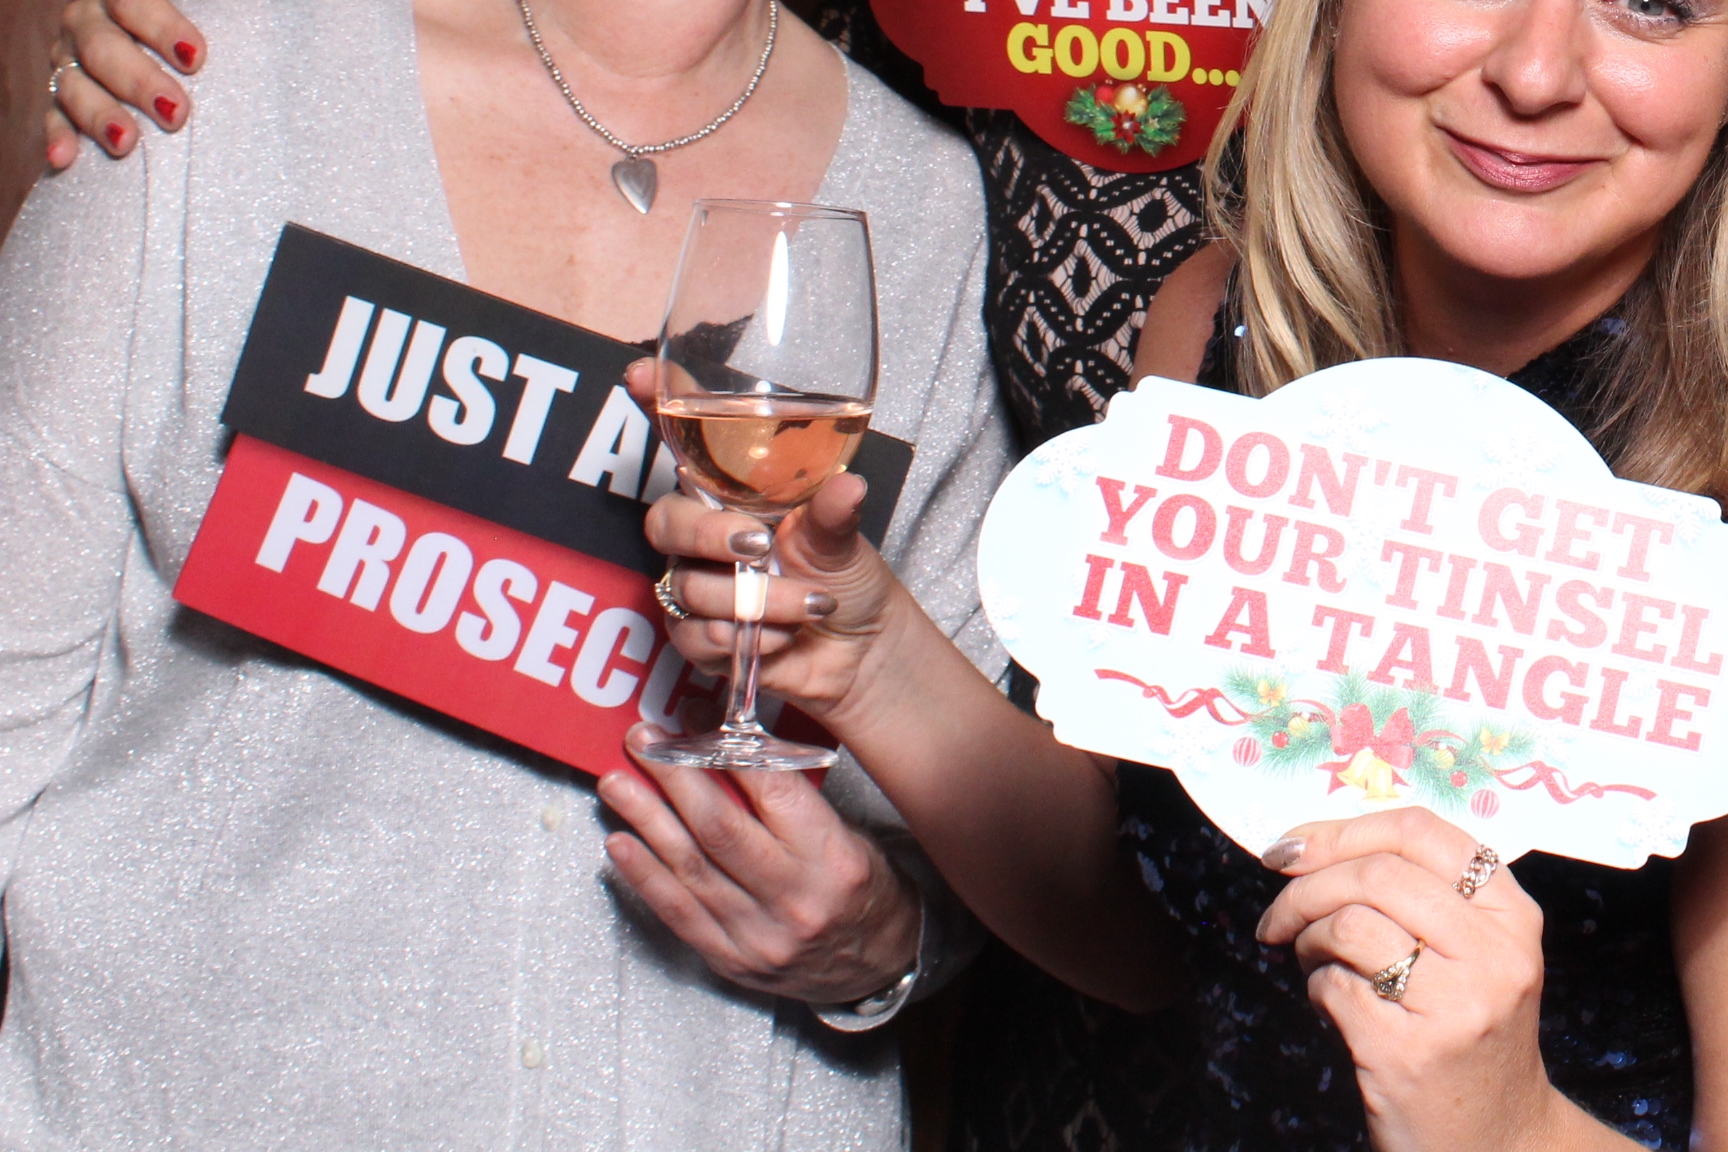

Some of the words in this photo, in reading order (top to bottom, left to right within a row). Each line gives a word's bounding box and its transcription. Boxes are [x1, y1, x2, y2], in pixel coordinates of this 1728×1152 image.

[1007, 22, 1241, 87] GOOD...
[304, 295, 579, 465] JUST
[1095, 476, 1348, 594] YOUR
[1380, 539, 1724, 677] TINSEL
[1156, 413, 1459, 536] DON'T
[1477, 486, 1674, 583] GET
[1072, 553, 1189, 637] IN
[1204, 585, 1277, 659] A
[1311, 604, 1712, 752] TANGLE
